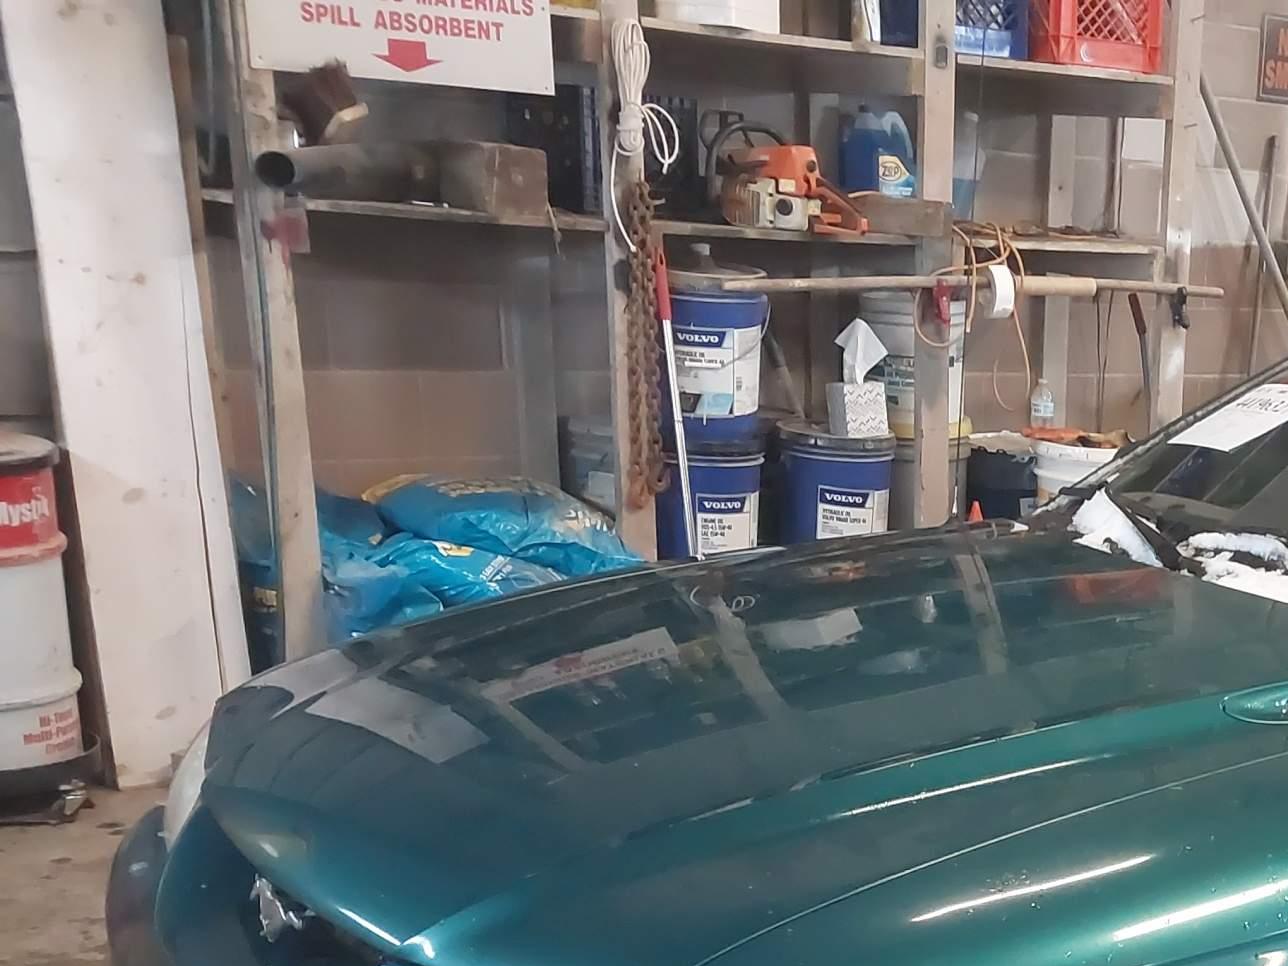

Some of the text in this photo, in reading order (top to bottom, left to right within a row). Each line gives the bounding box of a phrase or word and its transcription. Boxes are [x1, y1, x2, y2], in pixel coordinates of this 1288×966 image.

[301, 2, 504, 41] SPILL ABSORBENT
[676, 332, 719, 343] VOLVO
[824, 492, 863, 504] VOLVO
[703, 501, 741, 510] VOLVO
